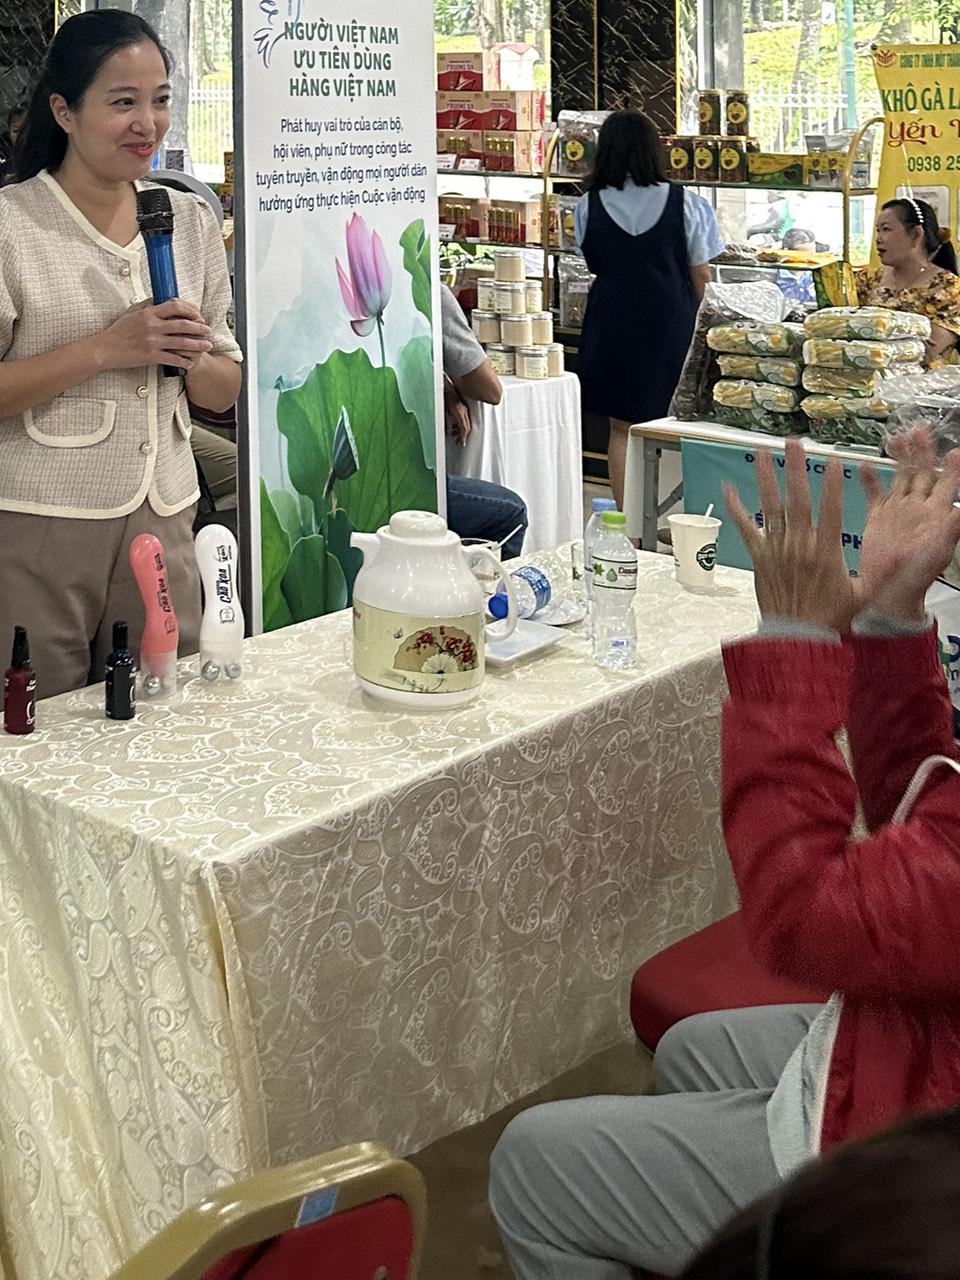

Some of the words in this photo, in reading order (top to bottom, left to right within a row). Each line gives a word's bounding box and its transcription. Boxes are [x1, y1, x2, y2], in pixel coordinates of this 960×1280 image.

[284, 17, 333, 41] NGƯỜI
[337, 19, 366, 48] VIỆT
[370, 27, 399, 45] NAM
[294, 49, 315, 68] ƯU
[319, 45, 350, 69] TIÊN
[354, 47, 392, 70] DÙNG
[290, 72, 330, 97] HÀNG
[333, 73, 363, 102] VIỆT
[367, 80, 396, 97] NAM
[881, 82, 918, 112] KHÔ
[921, 81, 944, 110] GÀ
[948, 87, 960, 110] L
[281, 119, 303, 133] Phát
[304, 119, 322, 135] huy
[324, 118, 338, 132] vai
[340, 118, 352, 131] trò
[354, 116, 371, 131] của
[273, 144, 289, 162] hội
[314, 143, 332, 161] phụ
[335, 141, 348, 156] nữ
[349, 143, 373, 159] trong
[375, 141, 397, 158] công
[398, 140, 412, 154] tác
[907, 155, 941, 172] 0938
[256, 170, 285, 189] tuyên
[321, 167, 338, 185] vận
[340, 166, 364, 184] động
[365, 165, 382, 182] mọi
[383, 164, 410, 181] người
[411, 163, 427, 177] dân
[259, 194, 292, 213] hưởng
[294, 194, 314, 211] ứng
[316, 192, 339, 210] thực
[340, 191, 360, 208] hiện
[362, 189, 384, 206] Cuộc
[386, 188, 402, 205] vận
[403, 186, 425, 204] động
